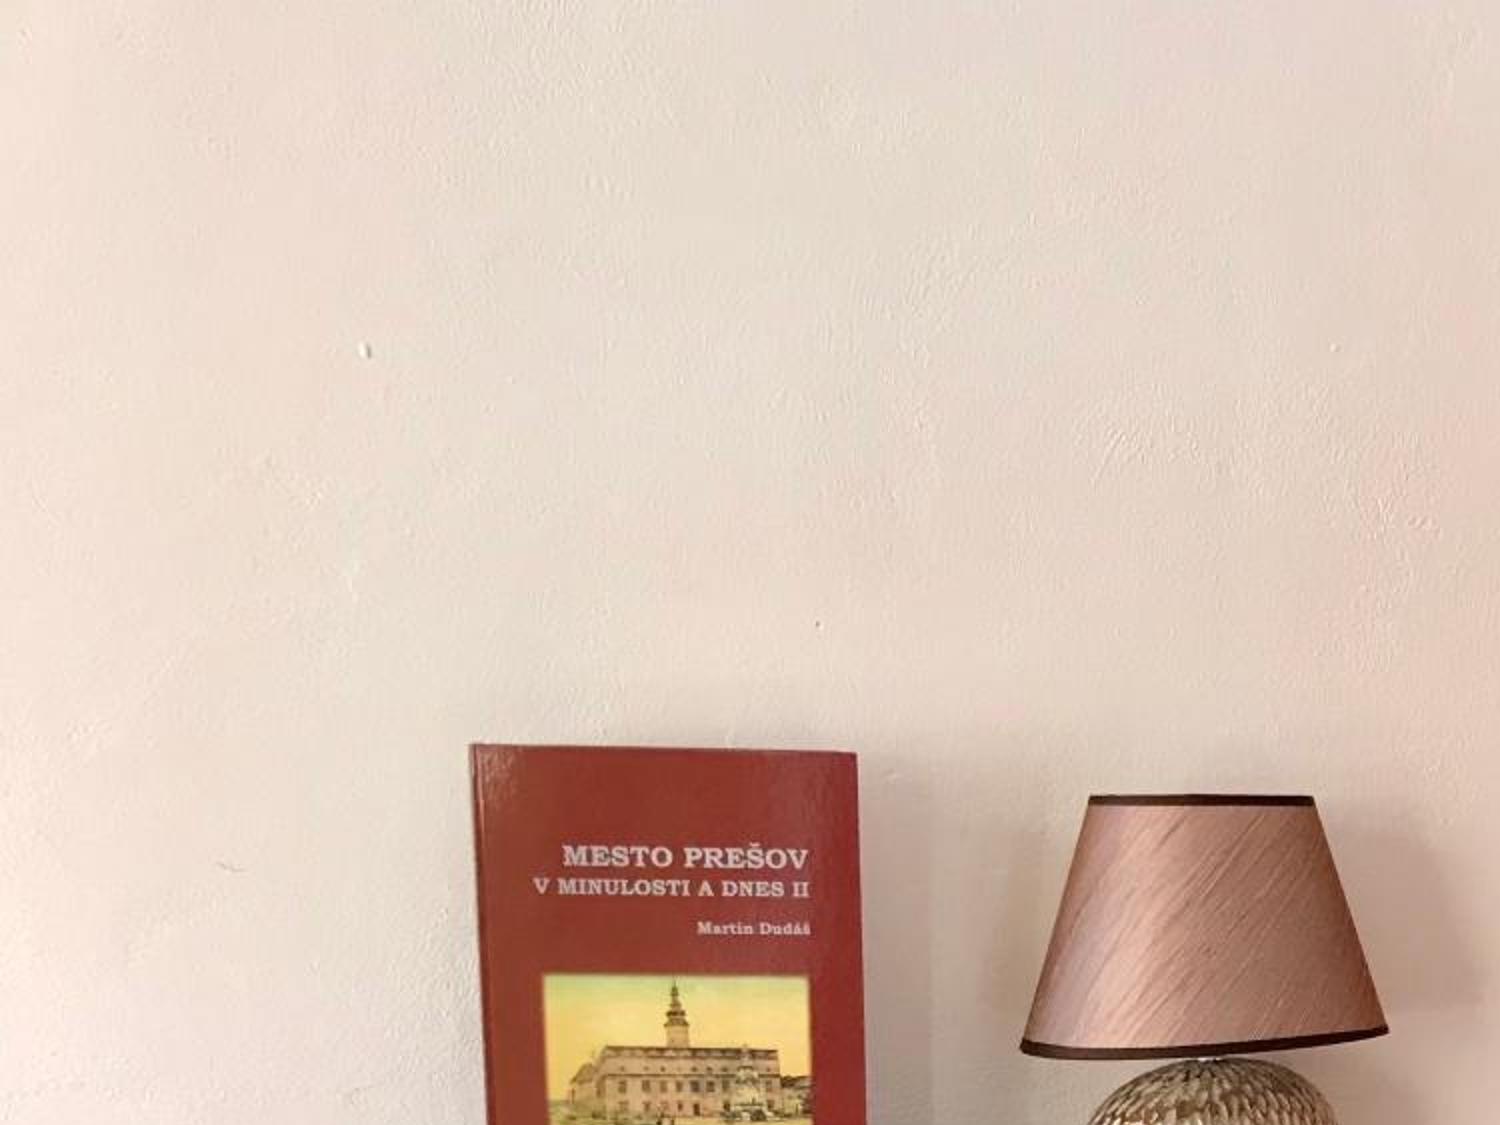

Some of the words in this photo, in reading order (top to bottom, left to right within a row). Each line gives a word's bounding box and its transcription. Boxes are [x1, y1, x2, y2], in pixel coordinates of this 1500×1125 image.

[561, 844, 673, 868] MESTO
[683, 841, 809, 869] PREŠOV
[532, 877, 550, 895] V
[557, 877, 690, 897] MINULOSTI
[698, 880, 714, 897] A
[722, 880, 785, 897] DNES
[792, 881, 810, 898] II
[696, 921, 754, 935] Martin
